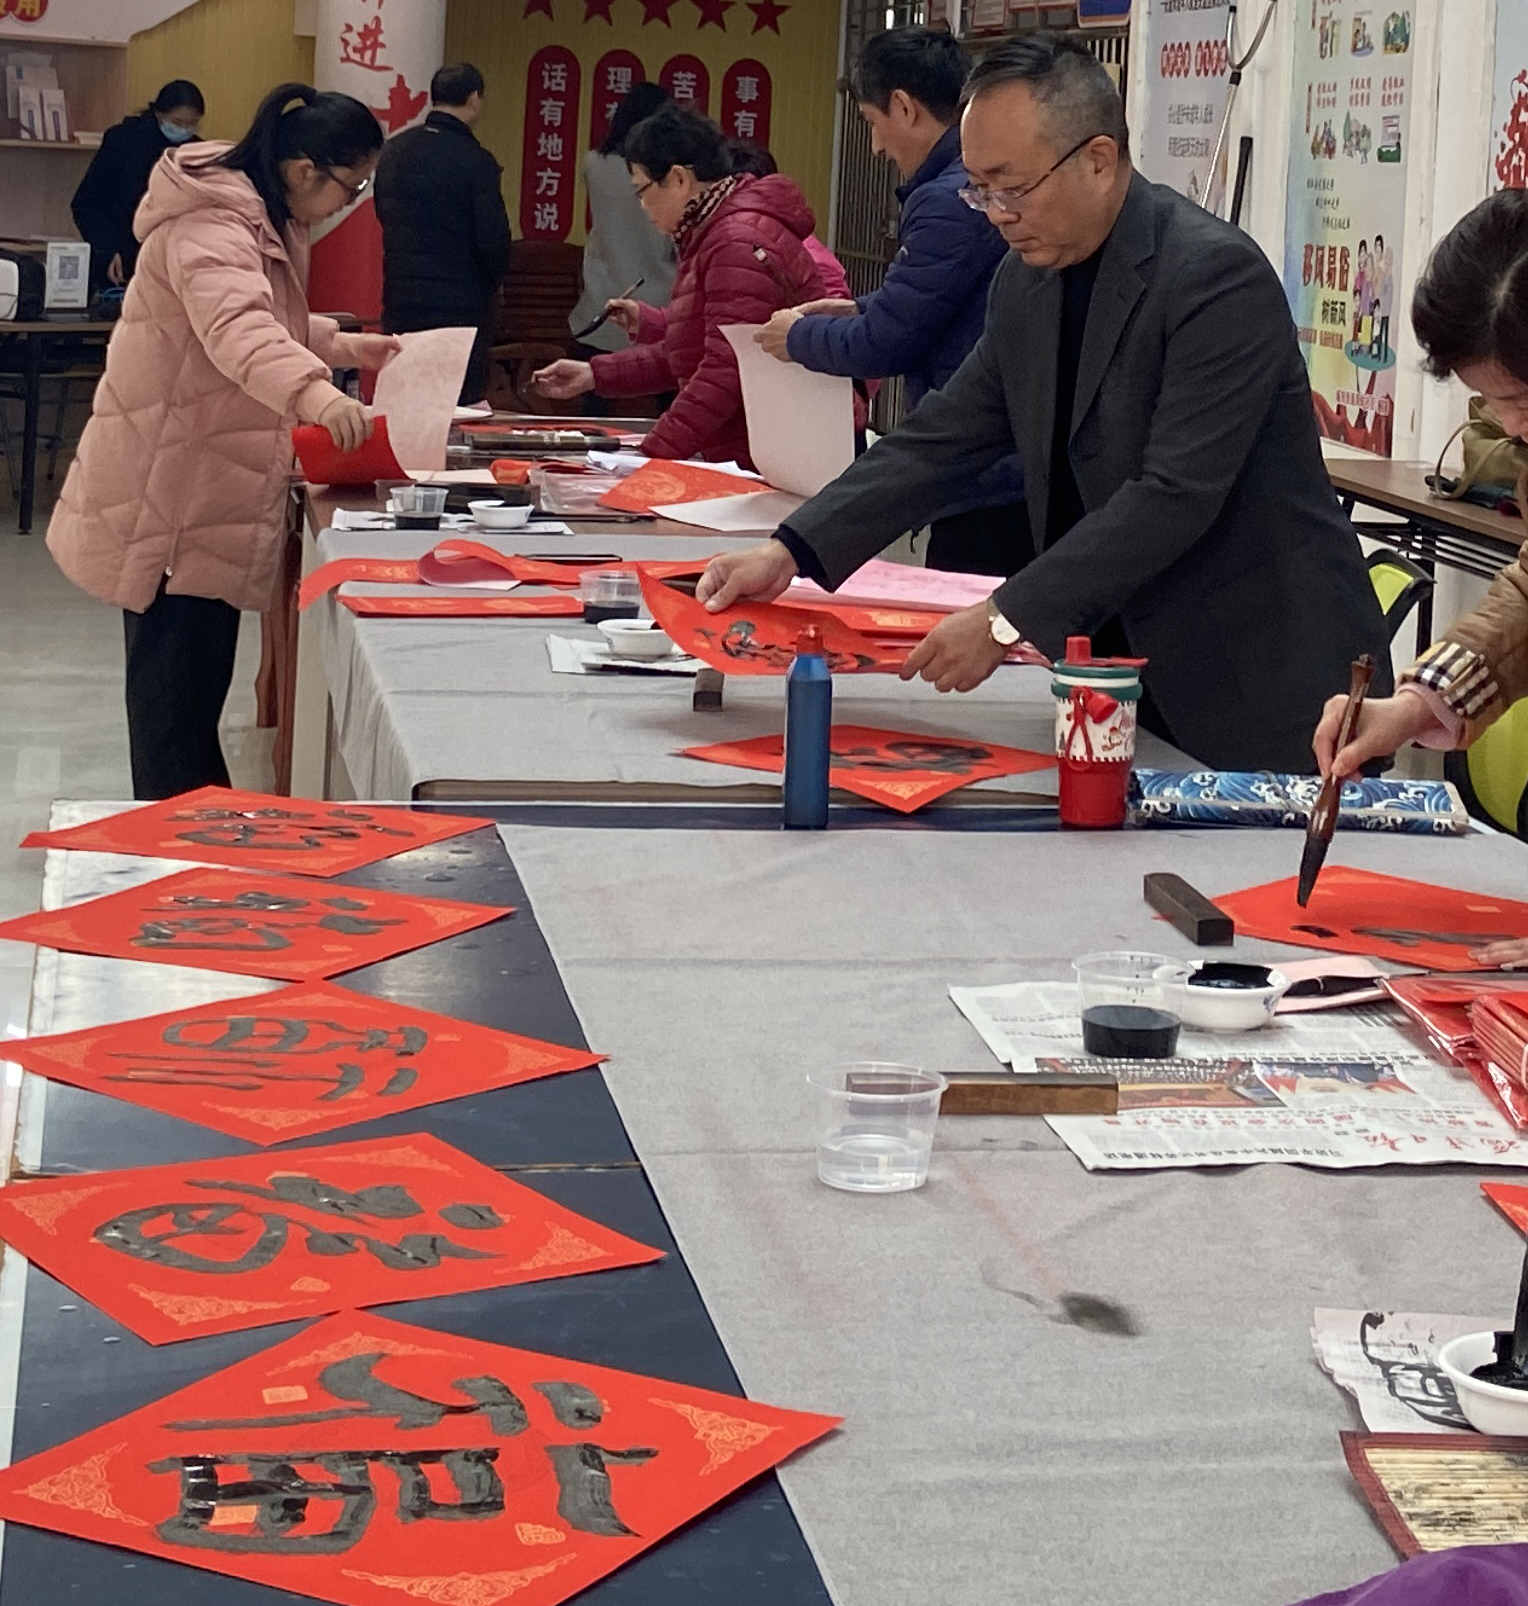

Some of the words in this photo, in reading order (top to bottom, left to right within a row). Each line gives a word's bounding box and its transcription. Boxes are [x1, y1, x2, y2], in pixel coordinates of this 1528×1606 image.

[340, 0, 393, 71] 进
[672, 72, 697, 100] 苦
[734, 76, 759, 138] 事有
[534, 63, 568, 232] 话有地方说
[93, 1171, 507, 1274] 福
[146, 1352, 660, 1557] 福
